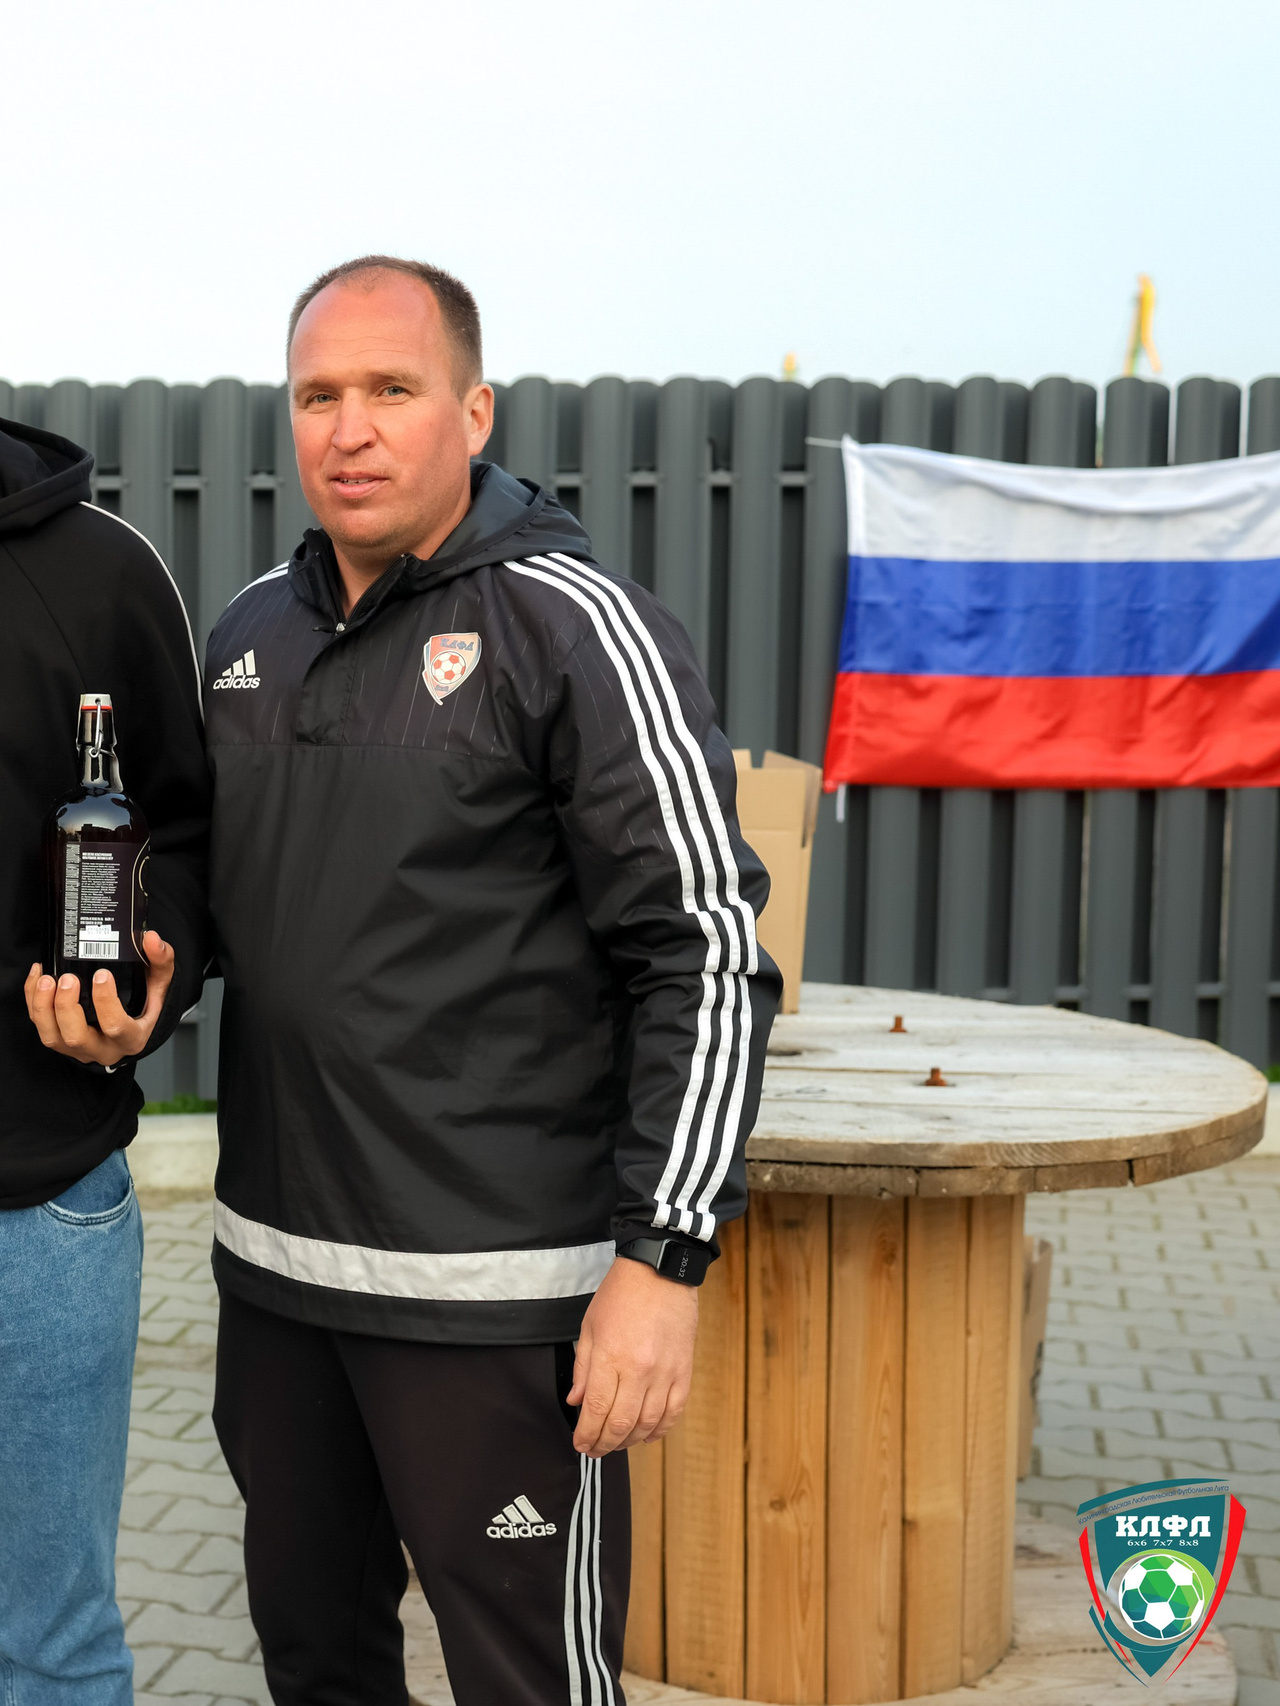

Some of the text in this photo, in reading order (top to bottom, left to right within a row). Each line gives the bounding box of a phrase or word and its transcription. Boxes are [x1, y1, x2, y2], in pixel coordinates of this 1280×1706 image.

[213, 675, 261, 690] adidas
[678, 1257, 689, 1278] 20:32
[486, 1522, 557, 1539] adidas
